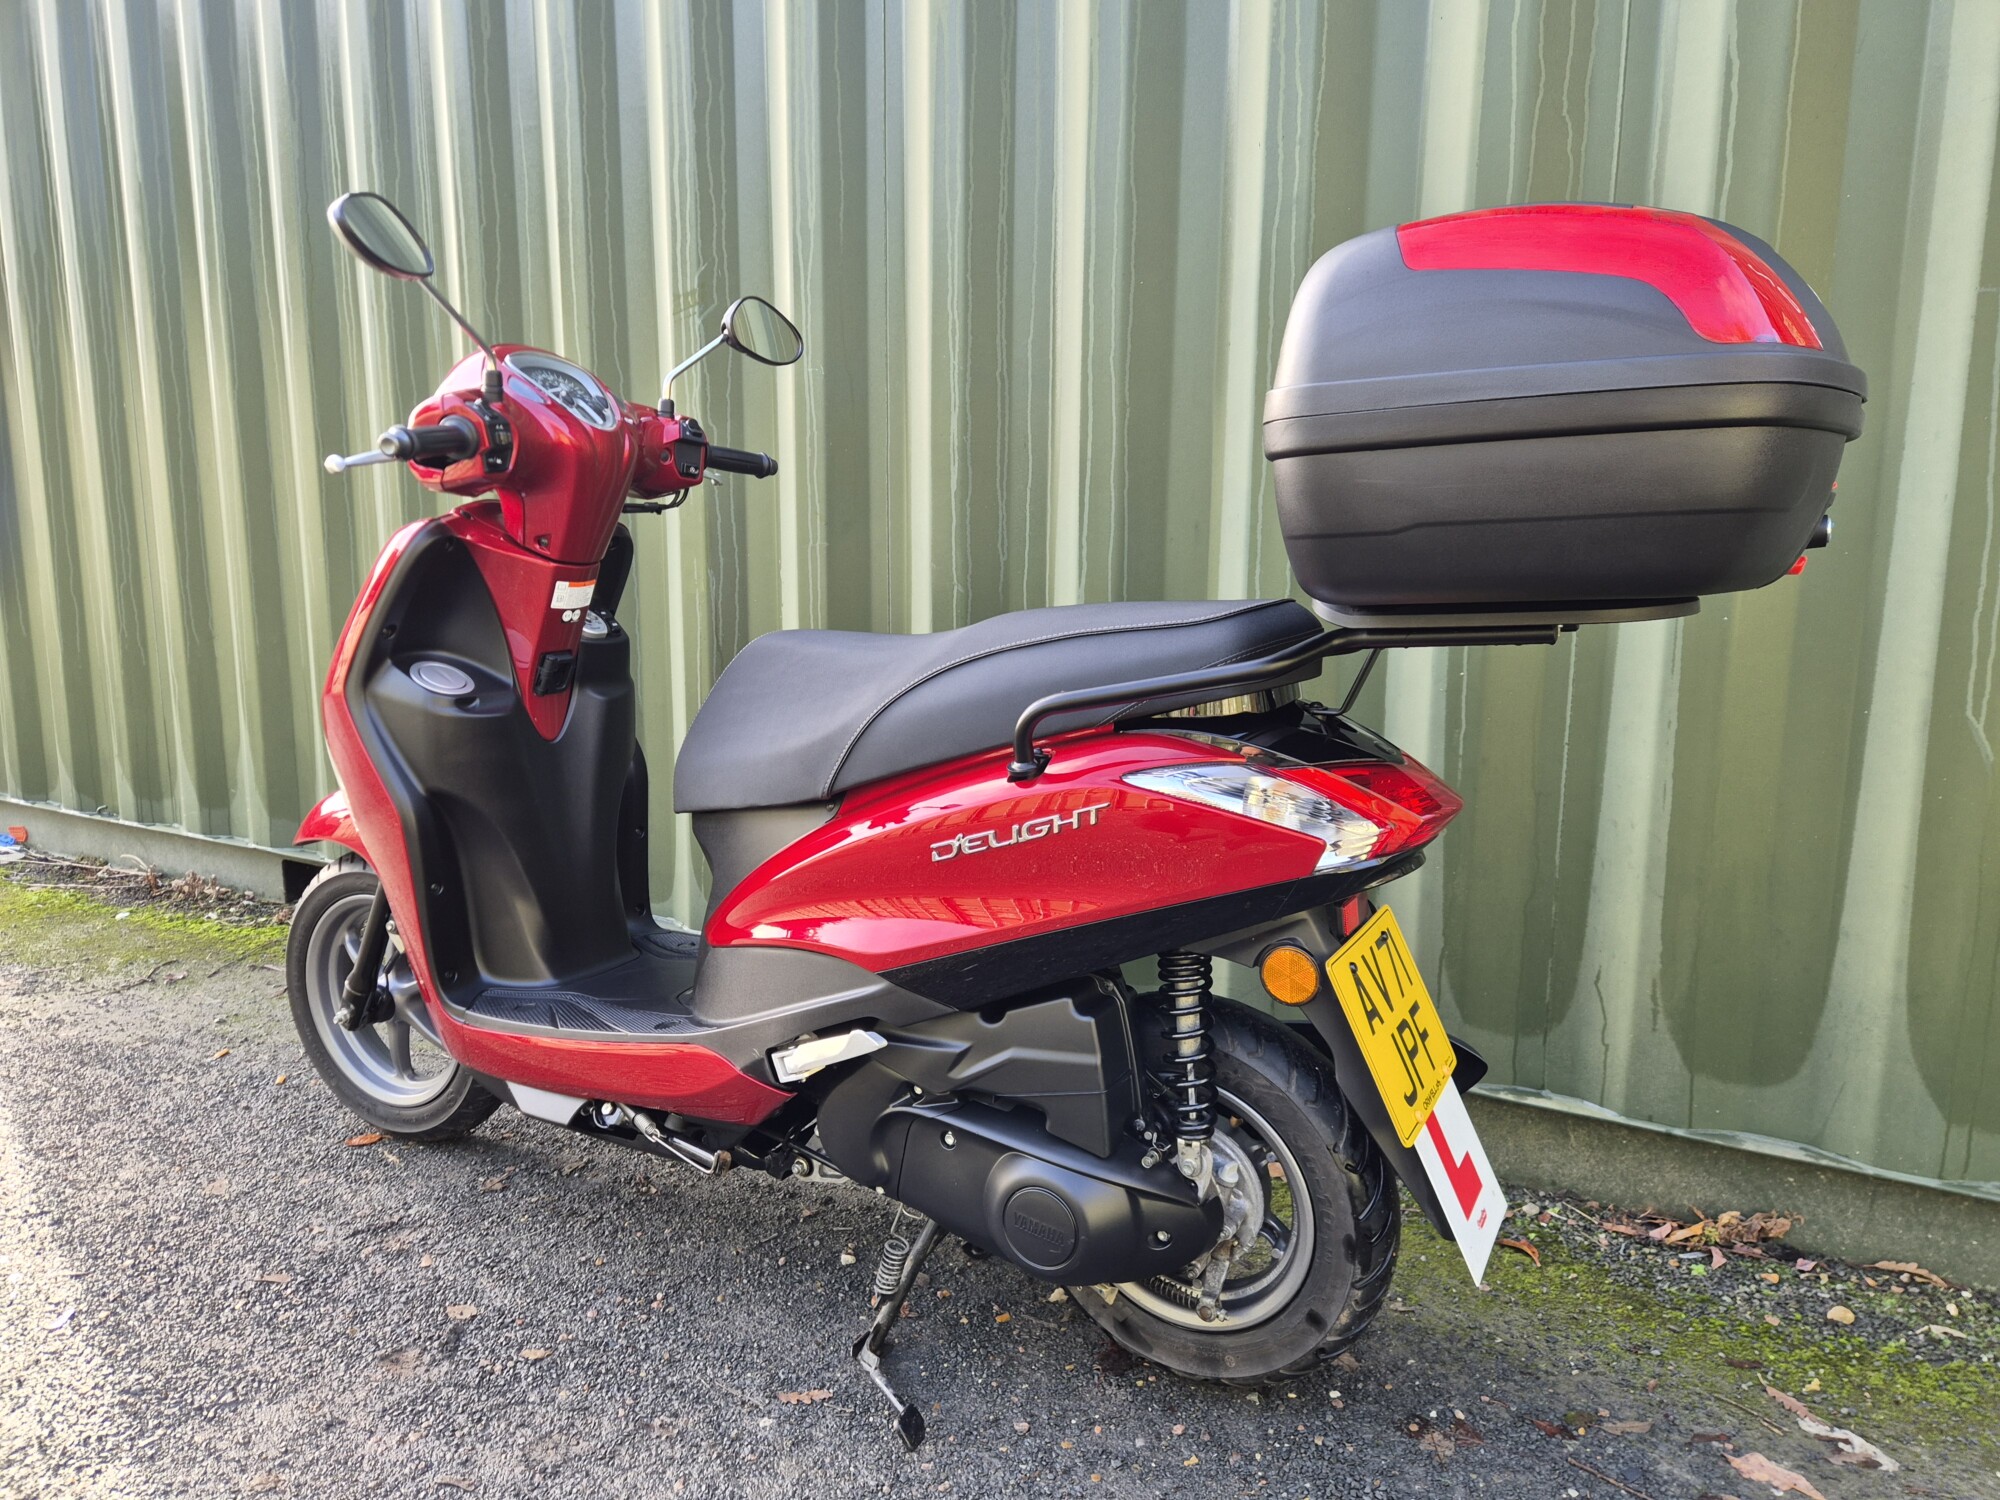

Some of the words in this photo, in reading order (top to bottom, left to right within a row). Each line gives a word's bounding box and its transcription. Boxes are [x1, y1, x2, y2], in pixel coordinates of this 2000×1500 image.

[930, 802, 1110, 862] D'ELIGHT
[1351, 927, 1414, 1036] AV71
[1391, 1000, 1435, 1108] JPF
[1014, 1211, 1065, 1247] YAMAHA
